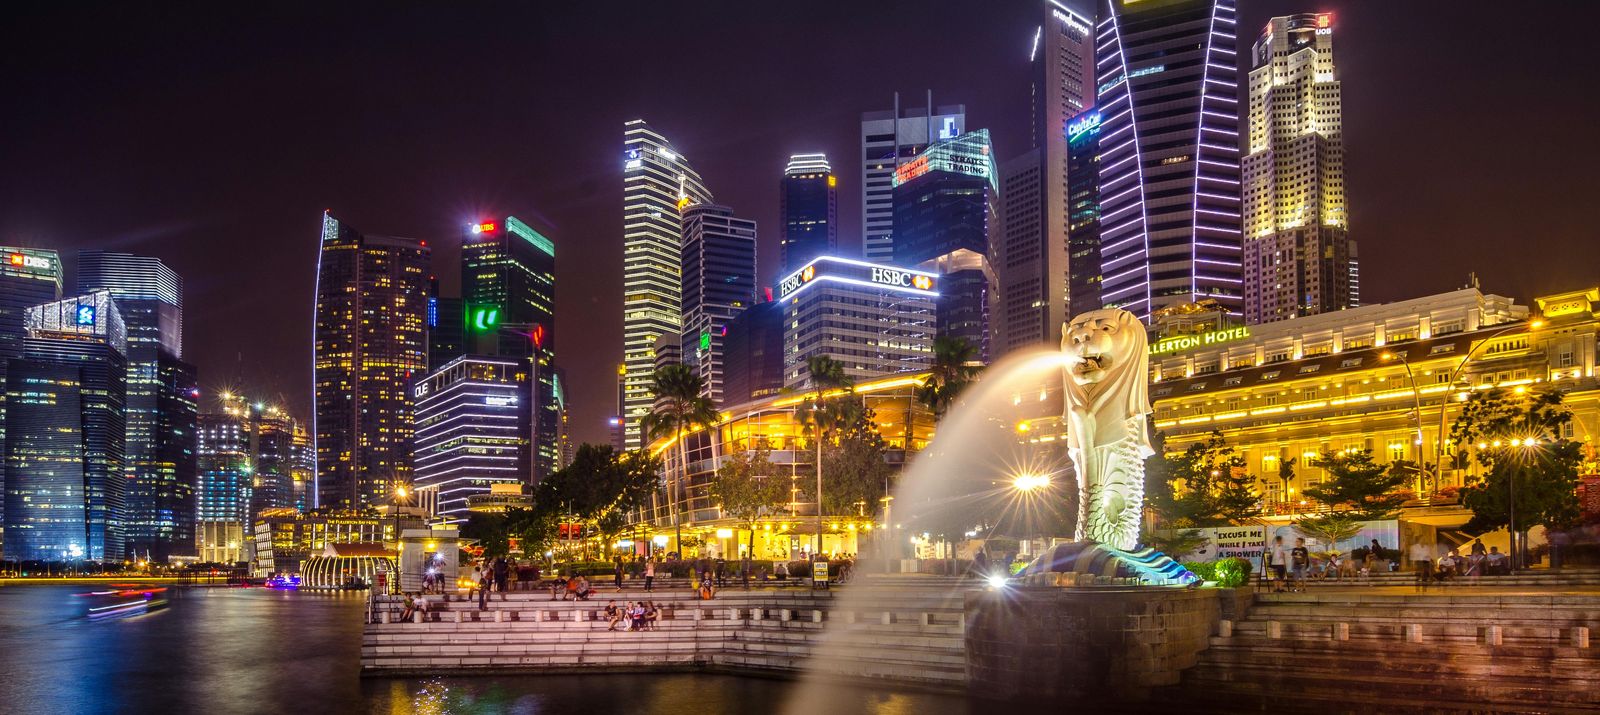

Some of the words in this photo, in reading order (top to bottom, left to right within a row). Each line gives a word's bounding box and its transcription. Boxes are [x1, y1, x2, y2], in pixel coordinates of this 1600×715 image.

[1315, 28, 1332, 36] UOB
[950, 154, 985, 166] STRAITS
[945, 162, 985, 175] TRADING
[24, 255, 50, 269] DBS
[871, 267, 912, 287] HSBC
[780, 272, 803, 298] HSBC
[1205, 326, 1250, 344] HOTEL
